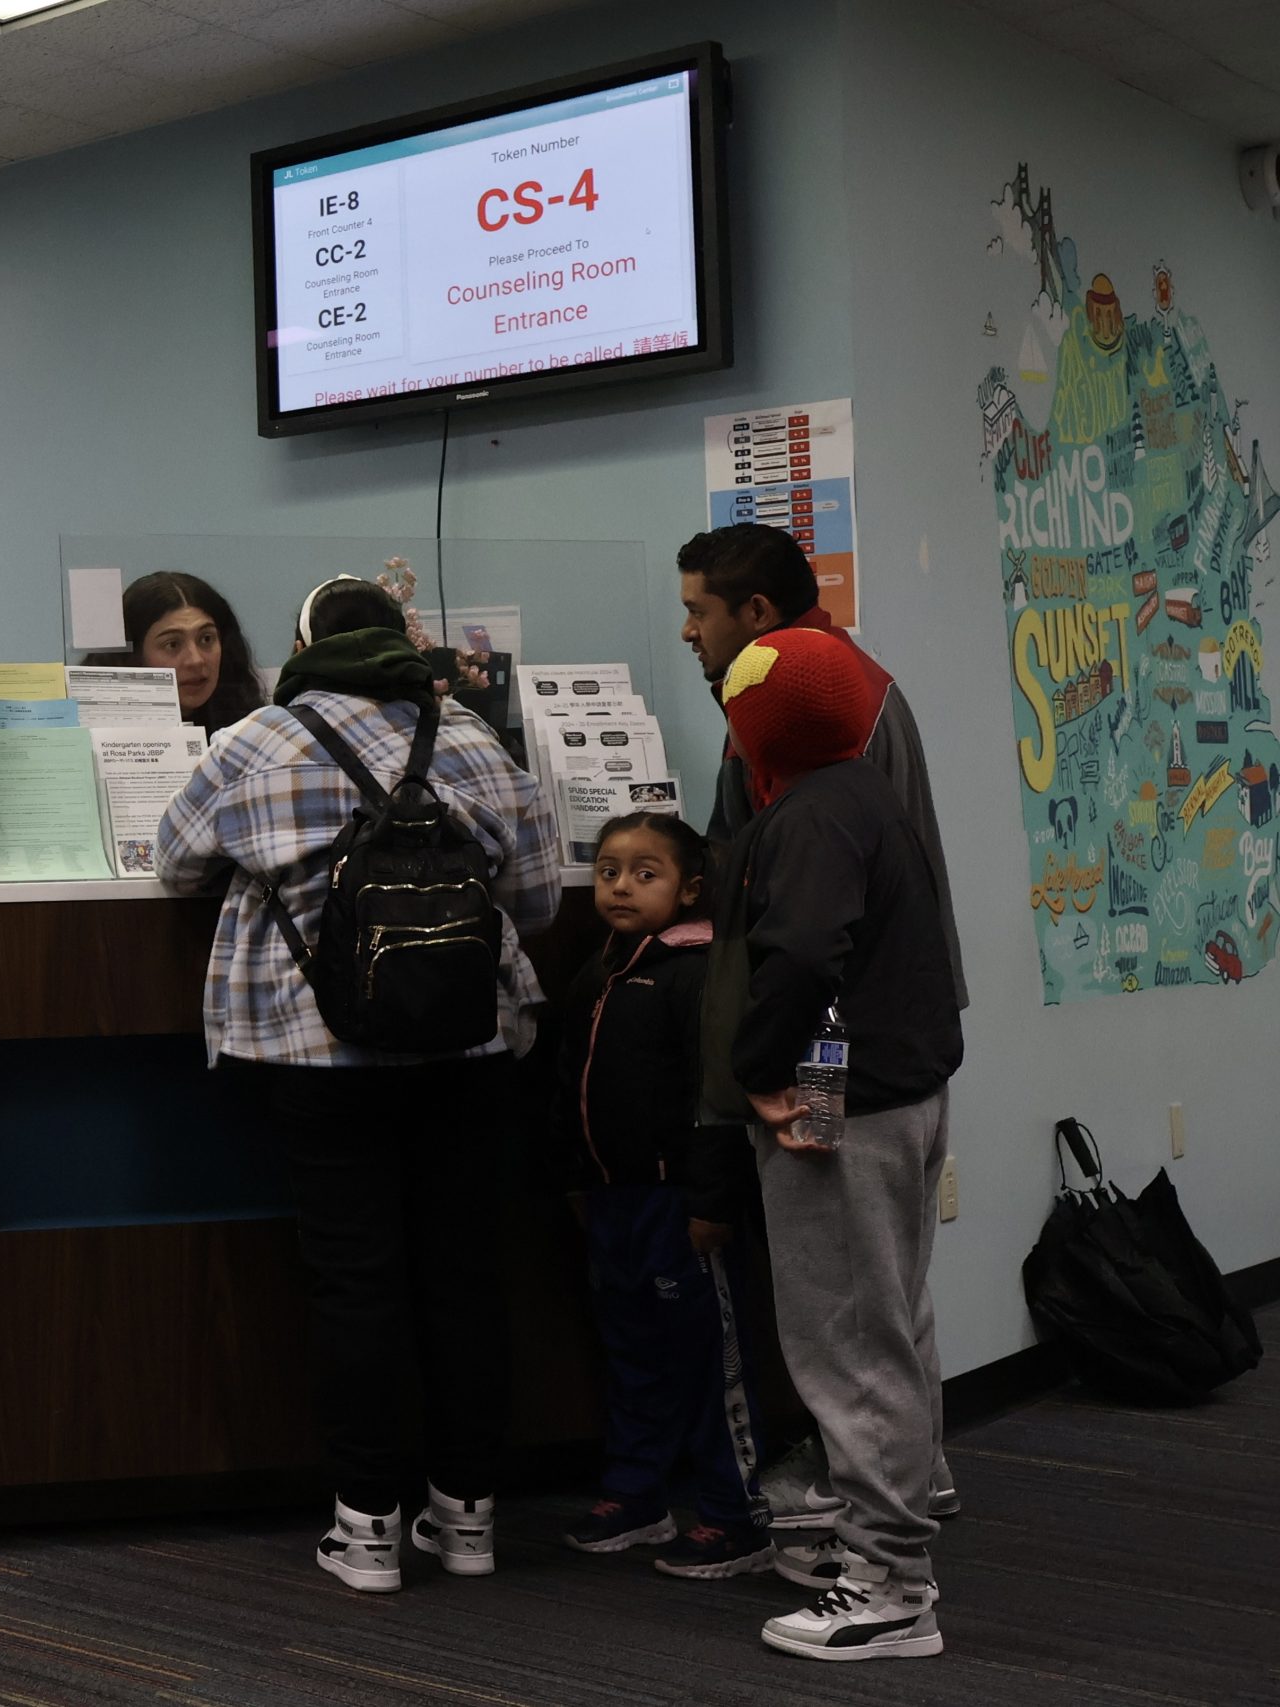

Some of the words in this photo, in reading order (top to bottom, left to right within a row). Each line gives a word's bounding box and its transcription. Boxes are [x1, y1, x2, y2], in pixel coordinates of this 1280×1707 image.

[491, 147, 528, 163] Token
[531, 135, 580, 155] Number
[295, 164, 318, 177] Token
[319, 190, 360, 217] IE-8
[477, 168, 599, 232] CS-4
[307, 227, 330, 239] Front
[332, 219, 365, 234] Counter
[366, 217, 373, 227] 4
[315, 239, 366, 267] CC-2
[489, 252, 525, 267] Please
[528, 241, 572, 258] Proceed
[576, 239, 590, 250] To
[304, 272, 352, 290] Counseling
[353, 267, 379, 280] Room
[323, 284, 361, 299] Entrance
[447, 269, 564, 306] Counseling
[571, 256, 636, 282] Room
[318, 302, 367, 329] CE-2
[494, 303, 588, 334] Entrance
[306, 334, 354, 352] Counseling
[355, 330, 380, 343] Room
[324, 347, 363, 361] Entrance
[314, 387, 367, 407] Please
[366, 380, 396, 398] wait
[401, 377, 422, 392] for
[426, 372, 459, 389] your
[464, 362, 524, 382] number
[528, 358, 544, 371] to
[550, 353, 569, 368] be
[456, 390, 490, 402] Panasonic
[1012, 418, 1053, 480] CLIFF
[999, 444, 1134, 549] RICHMOND
[1194, 460, 1228, 575] FINANCIAL
[1031, 554, 1088, 600] GOLDEN
[1086, 547, 1123, 576] GATE
[1220, 555, 1248, 626] BAY
[1225, 624, 1260, 668] POTRERO
[1012, 602, 1131, 794] SUNSET
[101, 741, 141, 749] Kindergarten
[142, 741, 172, 749] openings
[127, 749, 146, 757] Parks
[567, 786, 589, 795] SFUSD
[589, 787, 617, 796] SPECIAL
[569, 795, 608, 804] EDUCATION
[570, 804, 610, 812] HANDBOOK
[1153, 857, 1201, 927] EXCELSIOR
